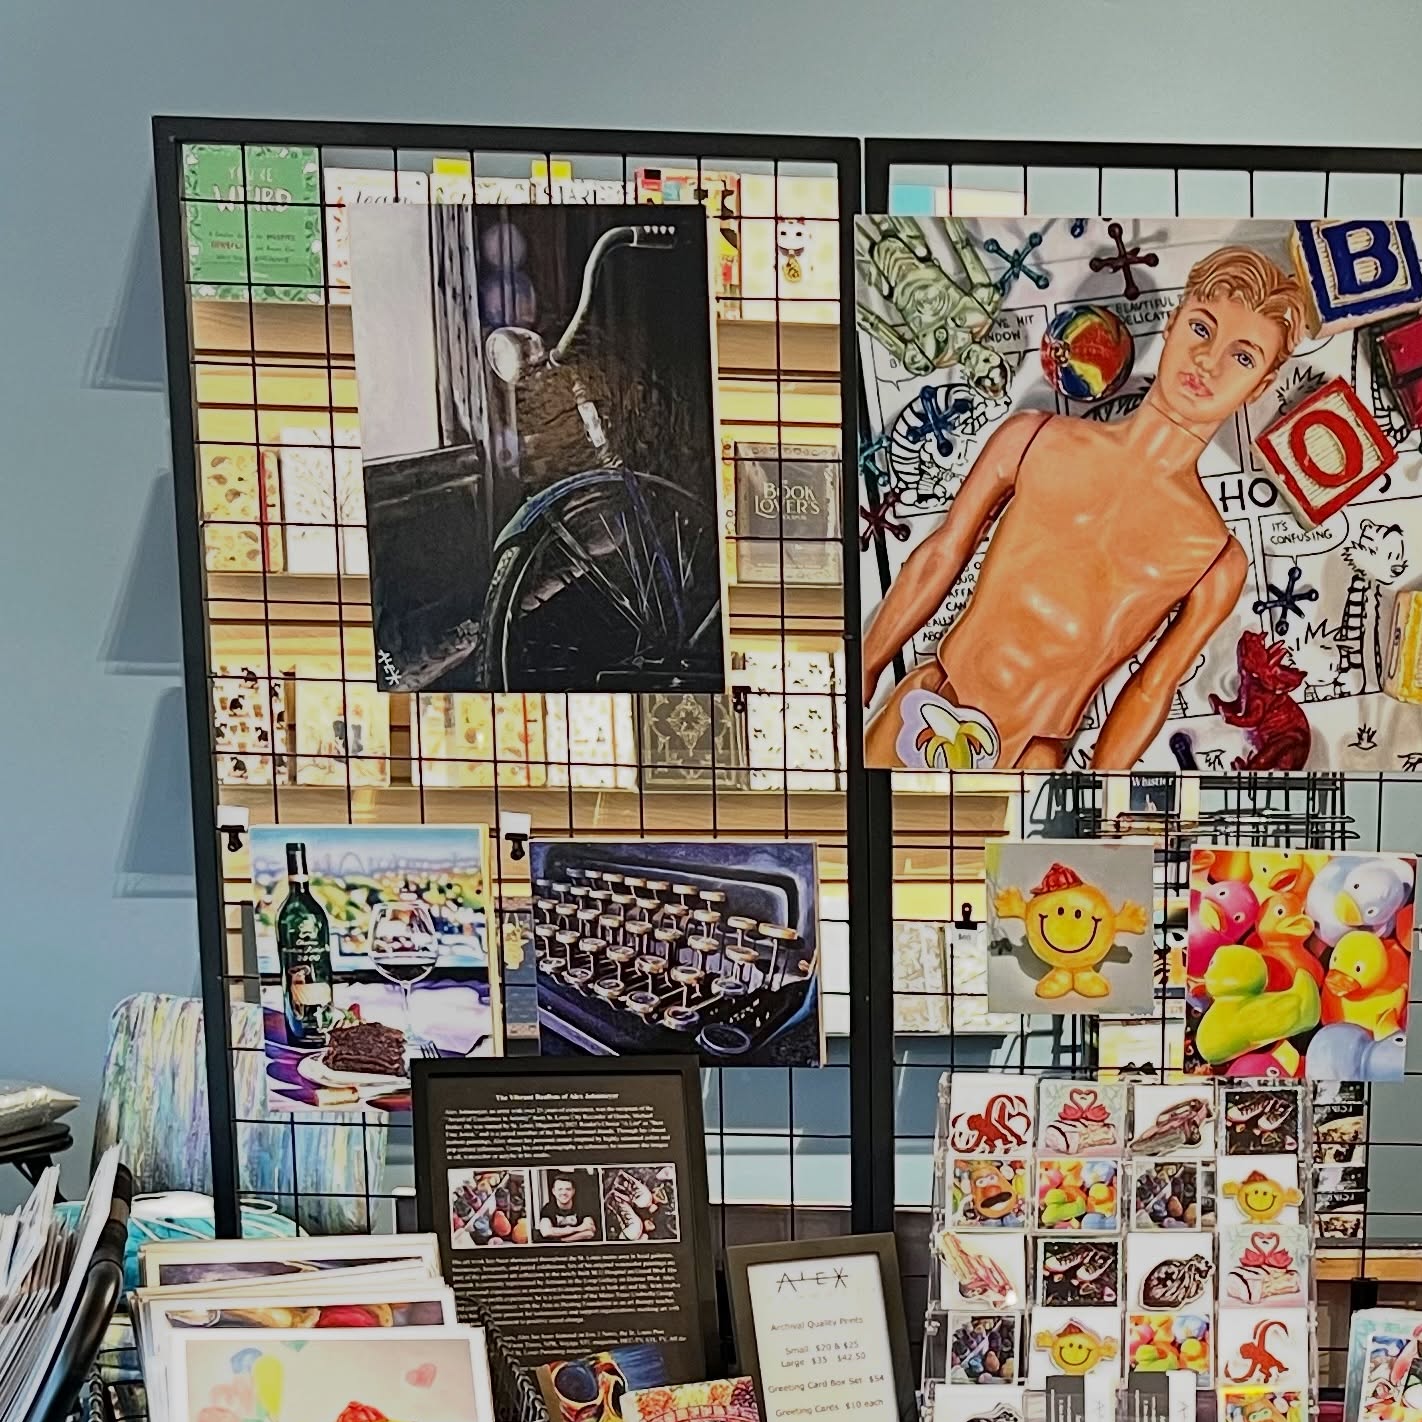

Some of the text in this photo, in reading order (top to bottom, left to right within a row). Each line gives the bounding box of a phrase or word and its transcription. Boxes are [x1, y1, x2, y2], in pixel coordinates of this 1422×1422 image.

[1321, 220, 1402, 296] B
[1017, 314, 1035, 325] HIT
[1290, 409, 1363, 488] O
[763, 482, 817, 501] BOOK
[1270, 529, 1333, 545] CONFUSING
[776, 1267, 848, 1293] ALEX
[771, 1316, 864, 1331] Archival Quality Prints
[768, 1383, 805, 1394] Greeting
[808, 1380, 828, 1389] Card
[830, 1379, 846, 1387] Box
[775, 1407, 813, 1418] Greeting
[864, 1399, 884, 1407] each
